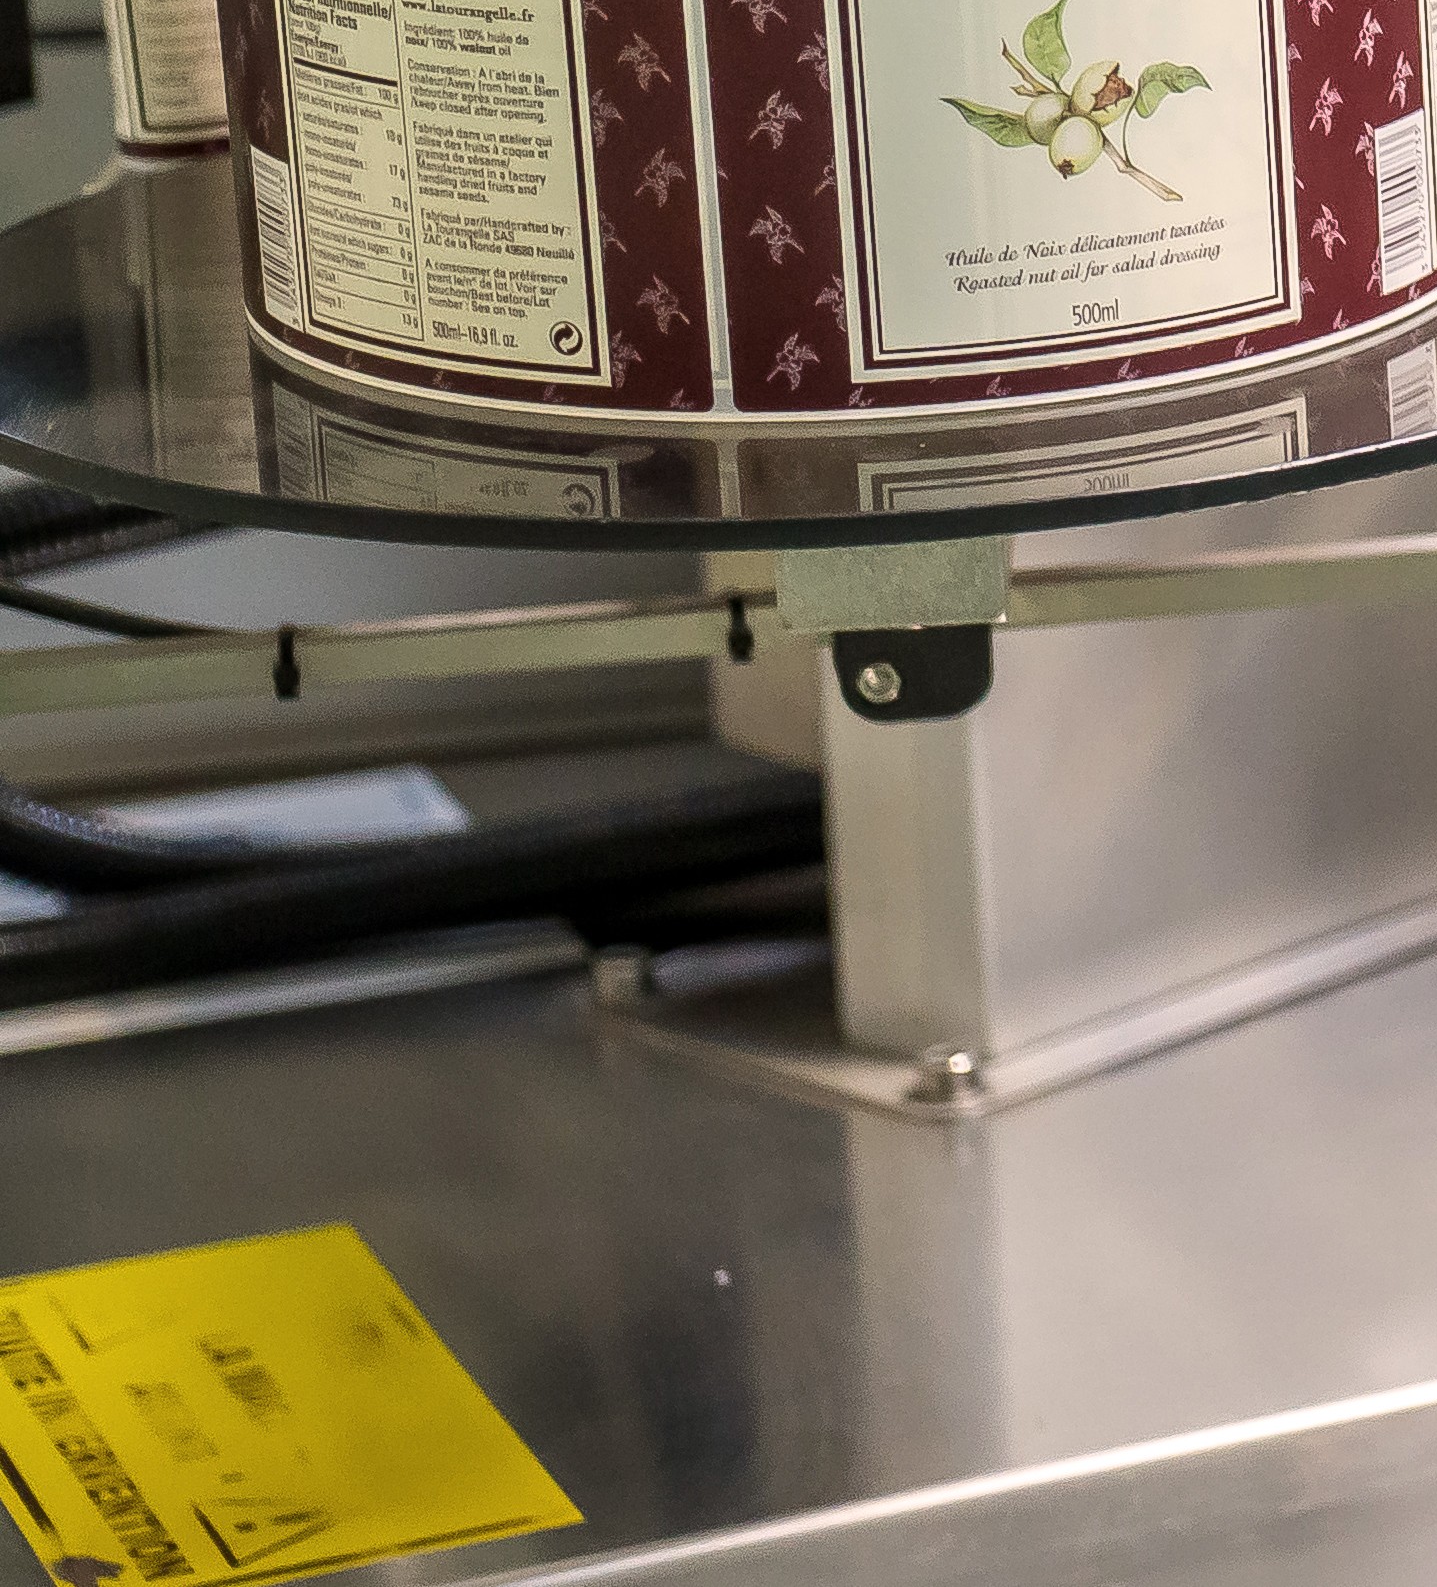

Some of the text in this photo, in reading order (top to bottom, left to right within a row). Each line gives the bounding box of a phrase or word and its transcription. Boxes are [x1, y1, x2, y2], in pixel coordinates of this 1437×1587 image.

[330, 9, 358, 30] Facts
[401, 0, 535, 23] www.latourangelle.fr
[945, 216, 1226, 267] Huile de Noix délicatement toastées
[953, 242, 1221, 294] Roasted nut oil for salad dressing
[1071, 298, 1120, 327] 500ml
